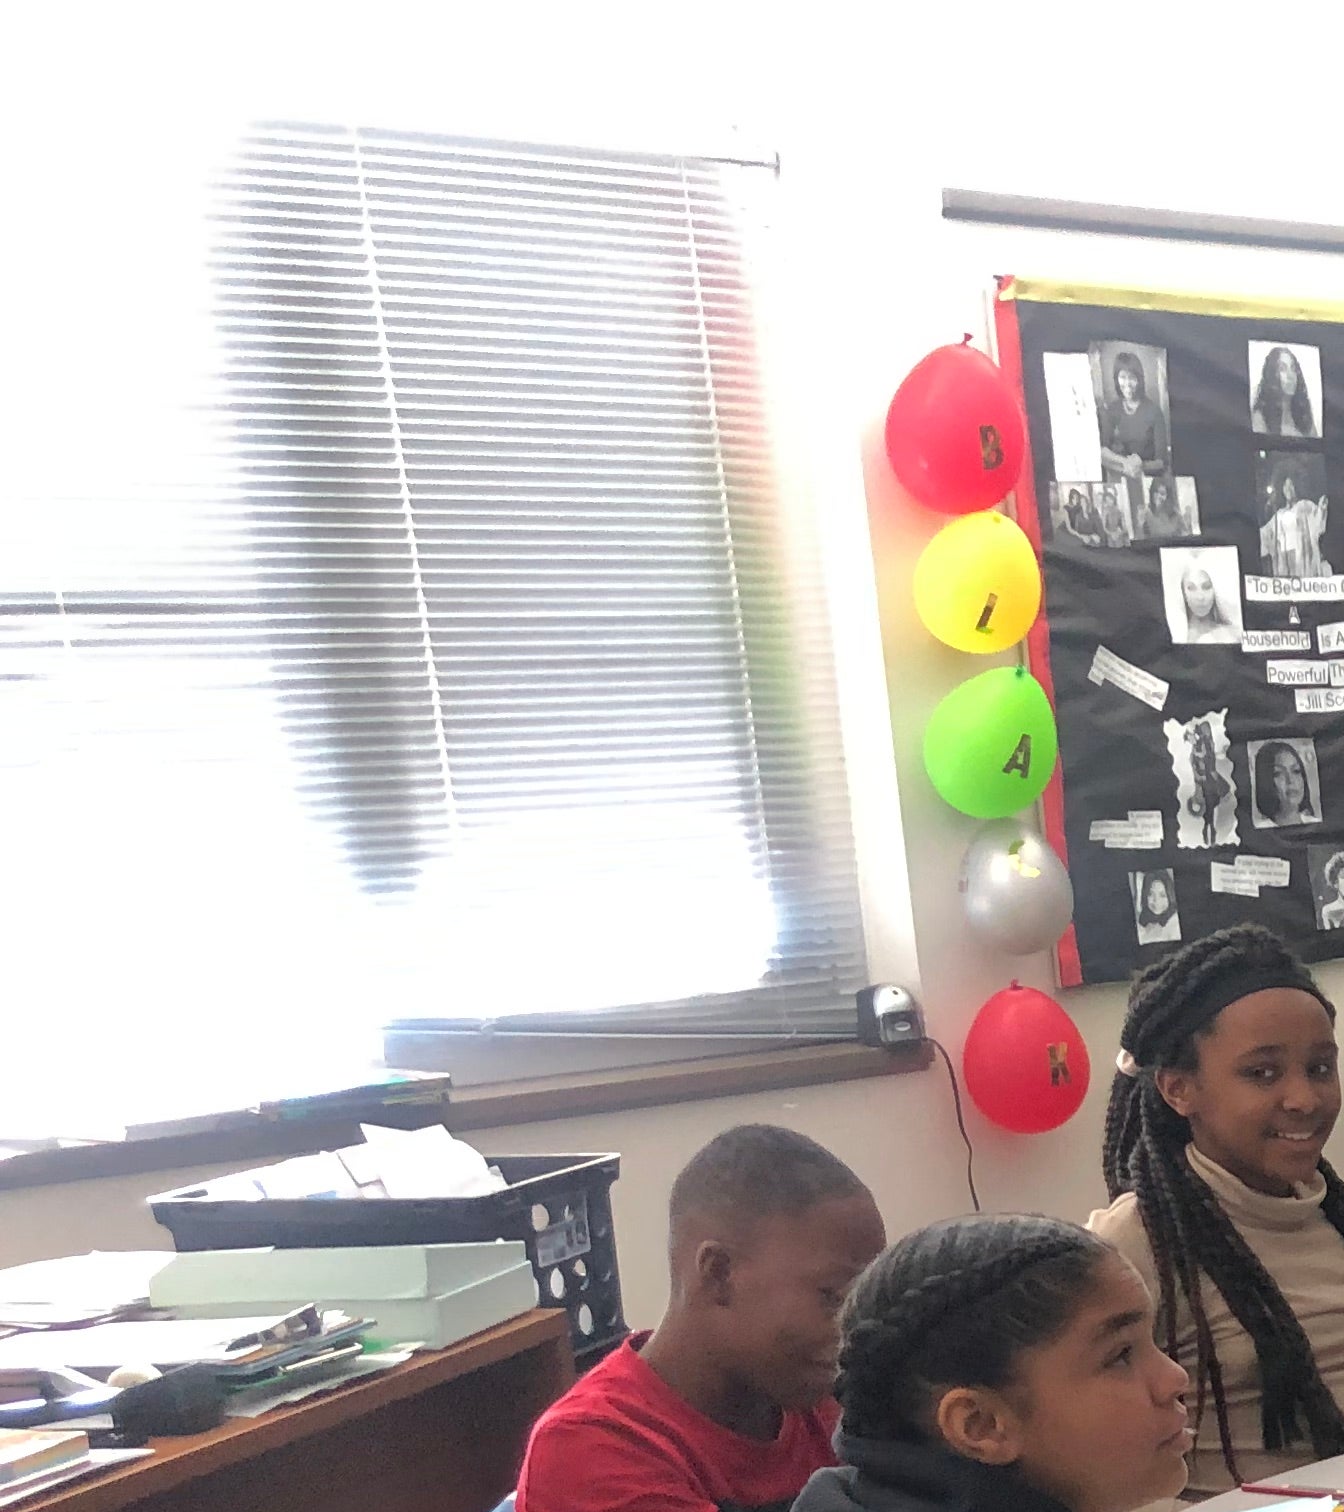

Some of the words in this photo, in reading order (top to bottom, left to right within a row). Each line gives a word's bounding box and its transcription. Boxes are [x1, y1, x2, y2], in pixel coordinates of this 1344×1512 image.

[979, 425, 1004, 471] B
[1273, 579, 1291, 595] Be
[1291, 577, 1337, 593] Queen
[1241, 631, 1310, 649] Household
[1268, 666, 1326, 683] Powerful
[1001, 733, 1032, 780] A
[1046, 1041, 1072, 1087] K
